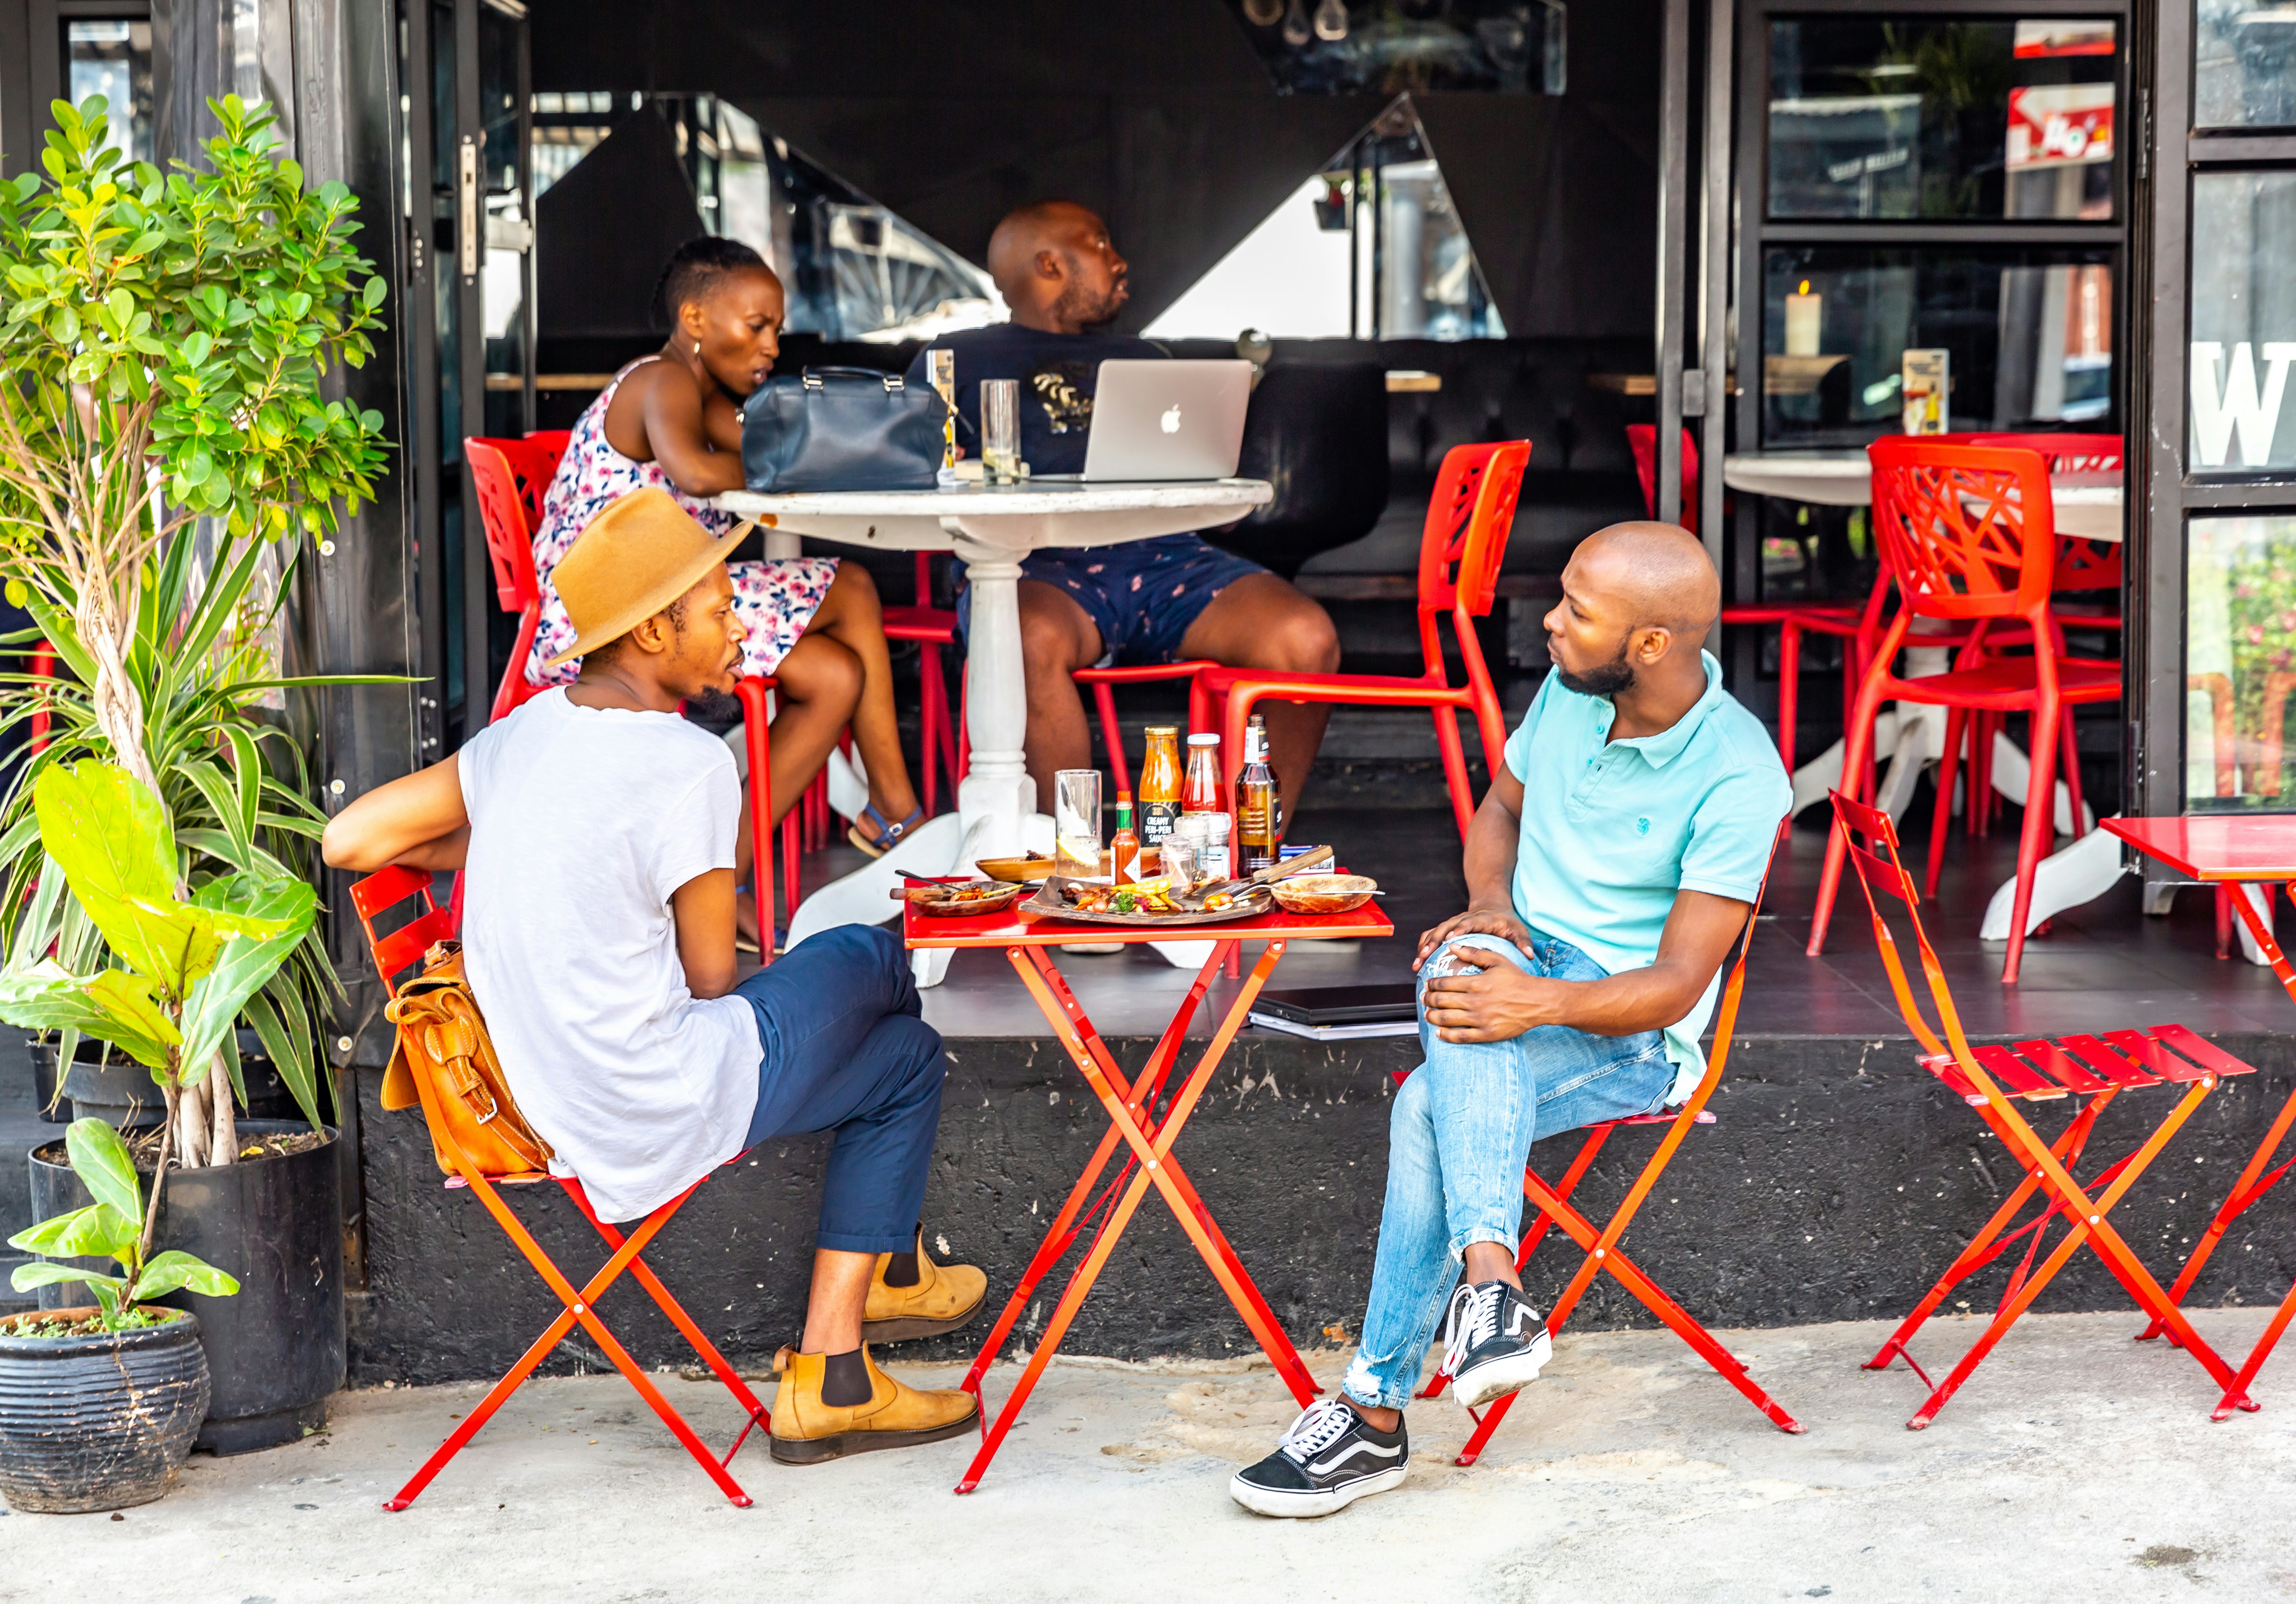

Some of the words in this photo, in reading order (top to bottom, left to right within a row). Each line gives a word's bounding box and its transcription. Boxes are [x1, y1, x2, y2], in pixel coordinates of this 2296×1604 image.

[2191, 341, 2296, 466] W
[1147, 817, 1169, 826] CREAMY
[1145, 825, 1172, 834] PERI-PERI
